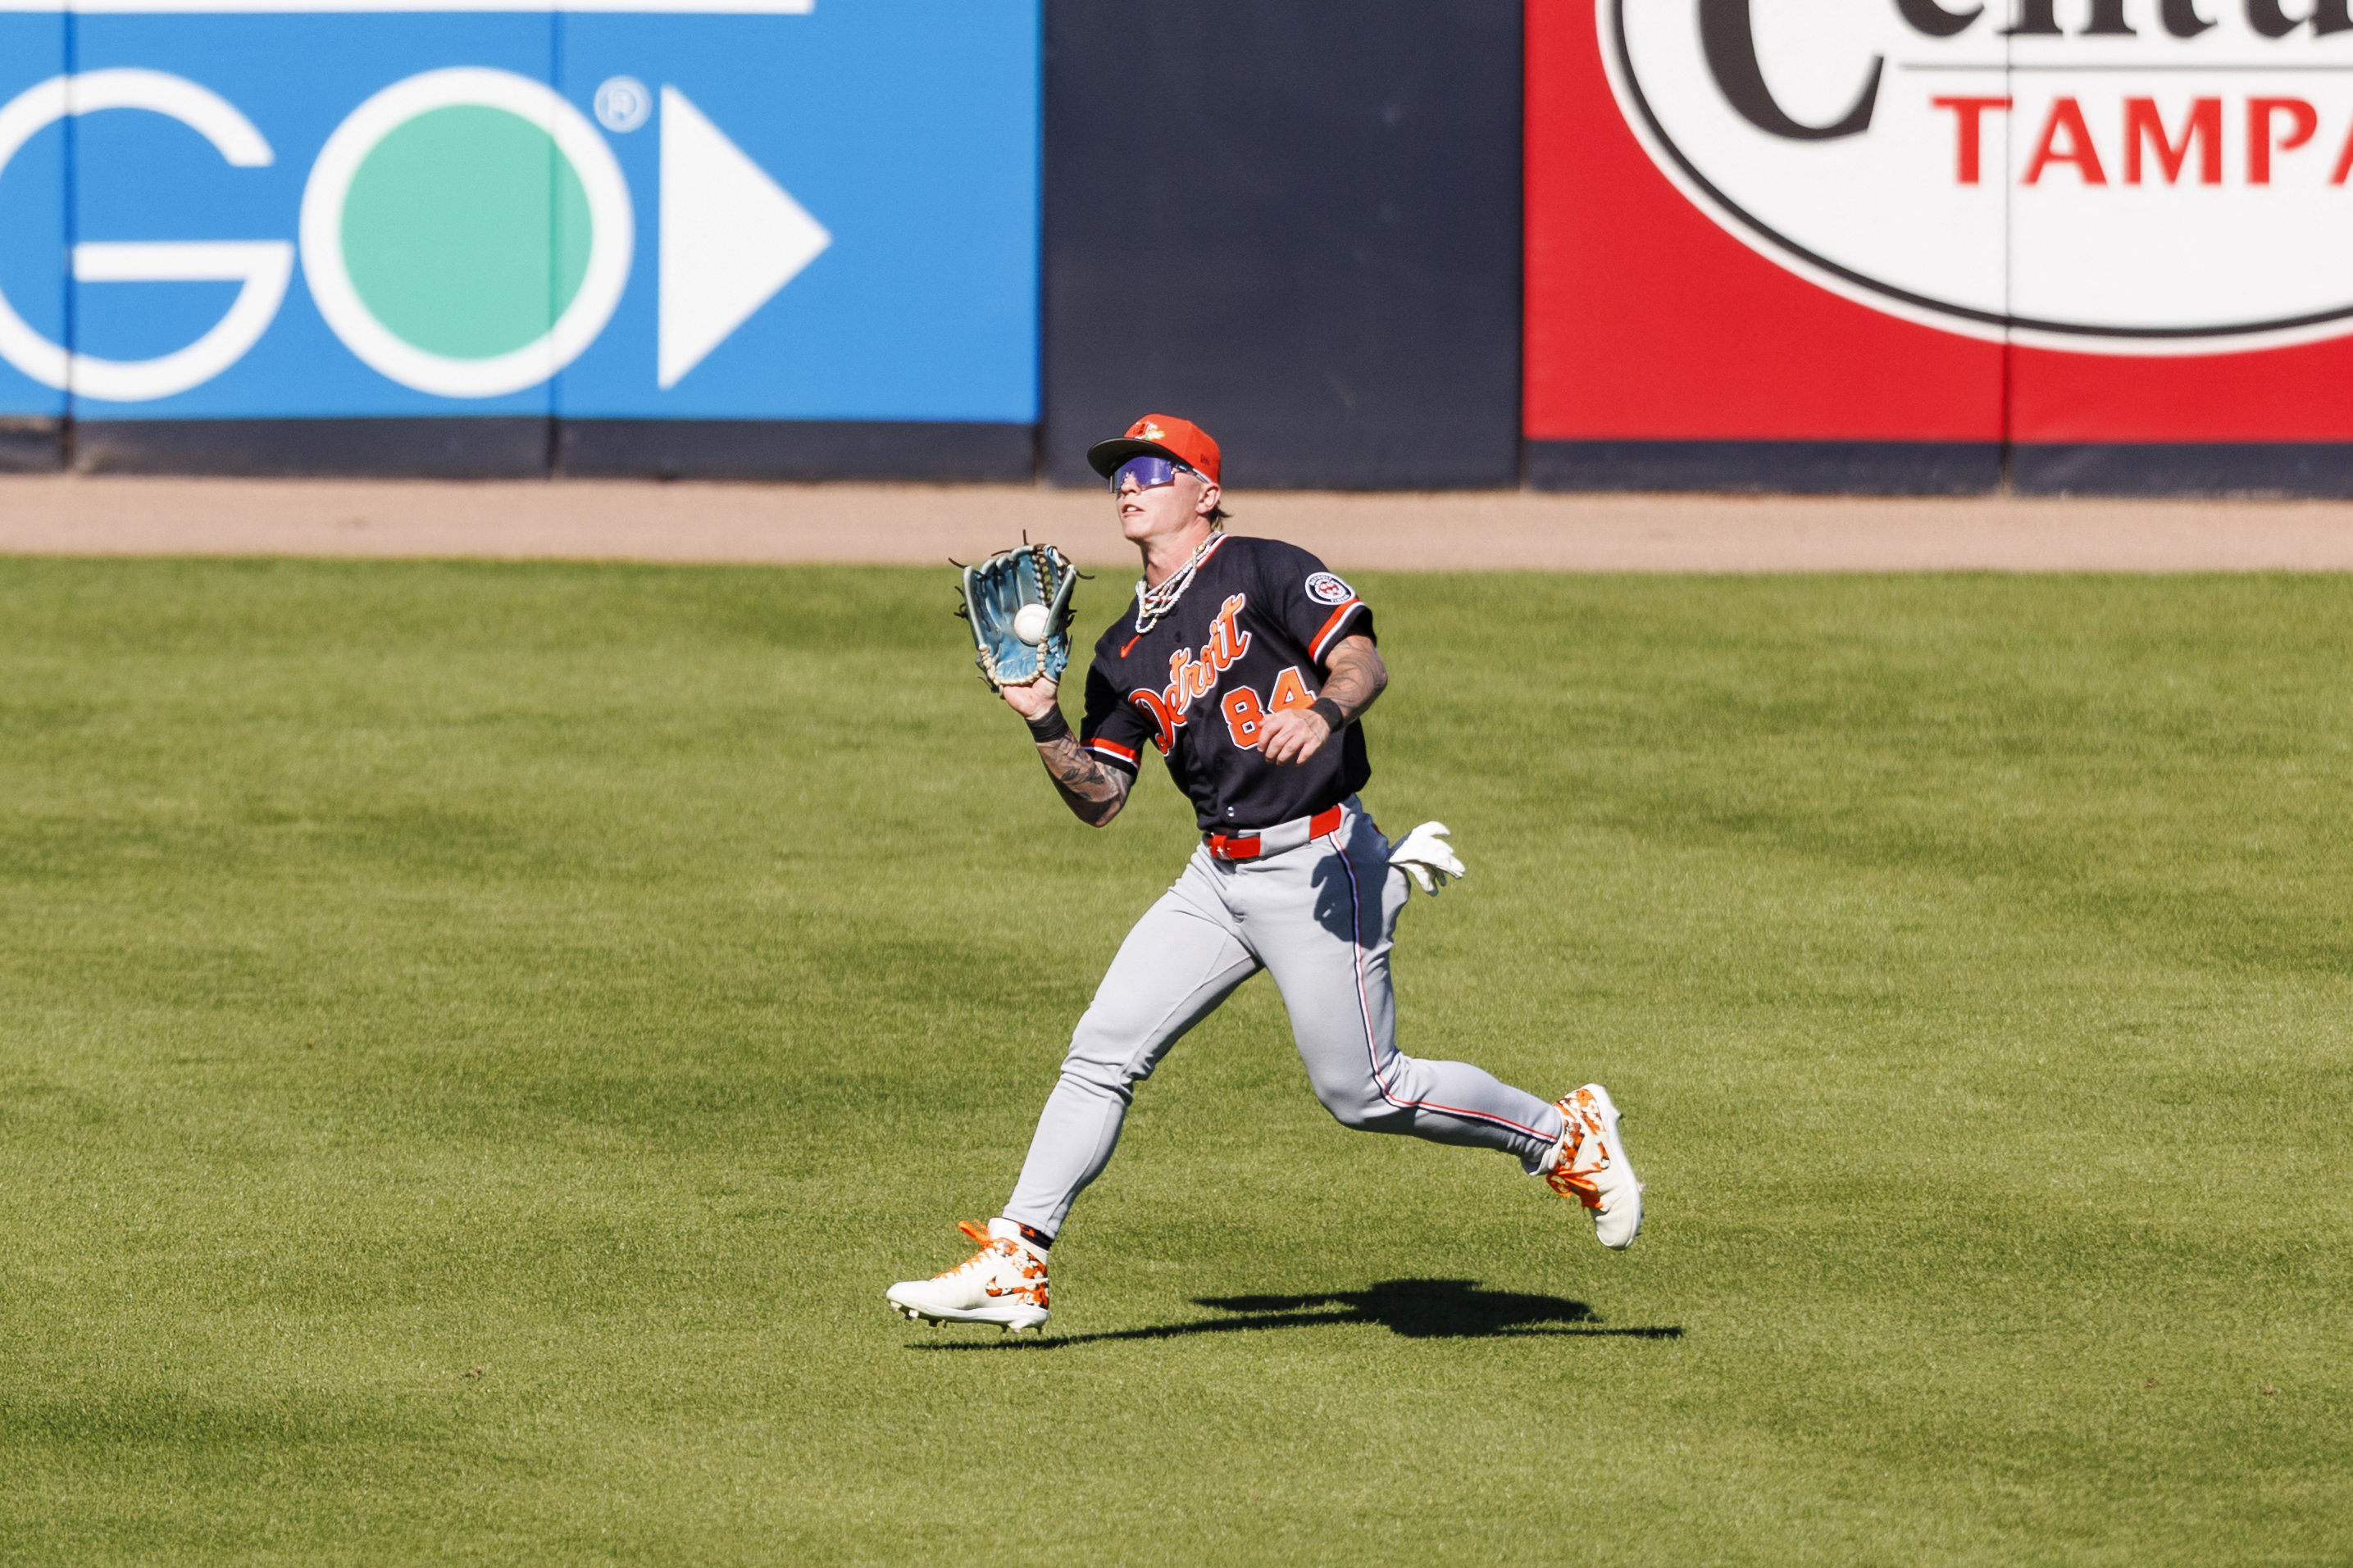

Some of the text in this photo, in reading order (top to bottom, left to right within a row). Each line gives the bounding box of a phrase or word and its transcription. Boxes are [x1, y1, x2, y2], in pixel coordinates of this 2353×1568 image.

[1929, 95, 2353, 188] TAMP
[1128, 593, 1253, 757] Detroit
[1221, 666, 1317, 751] 84
